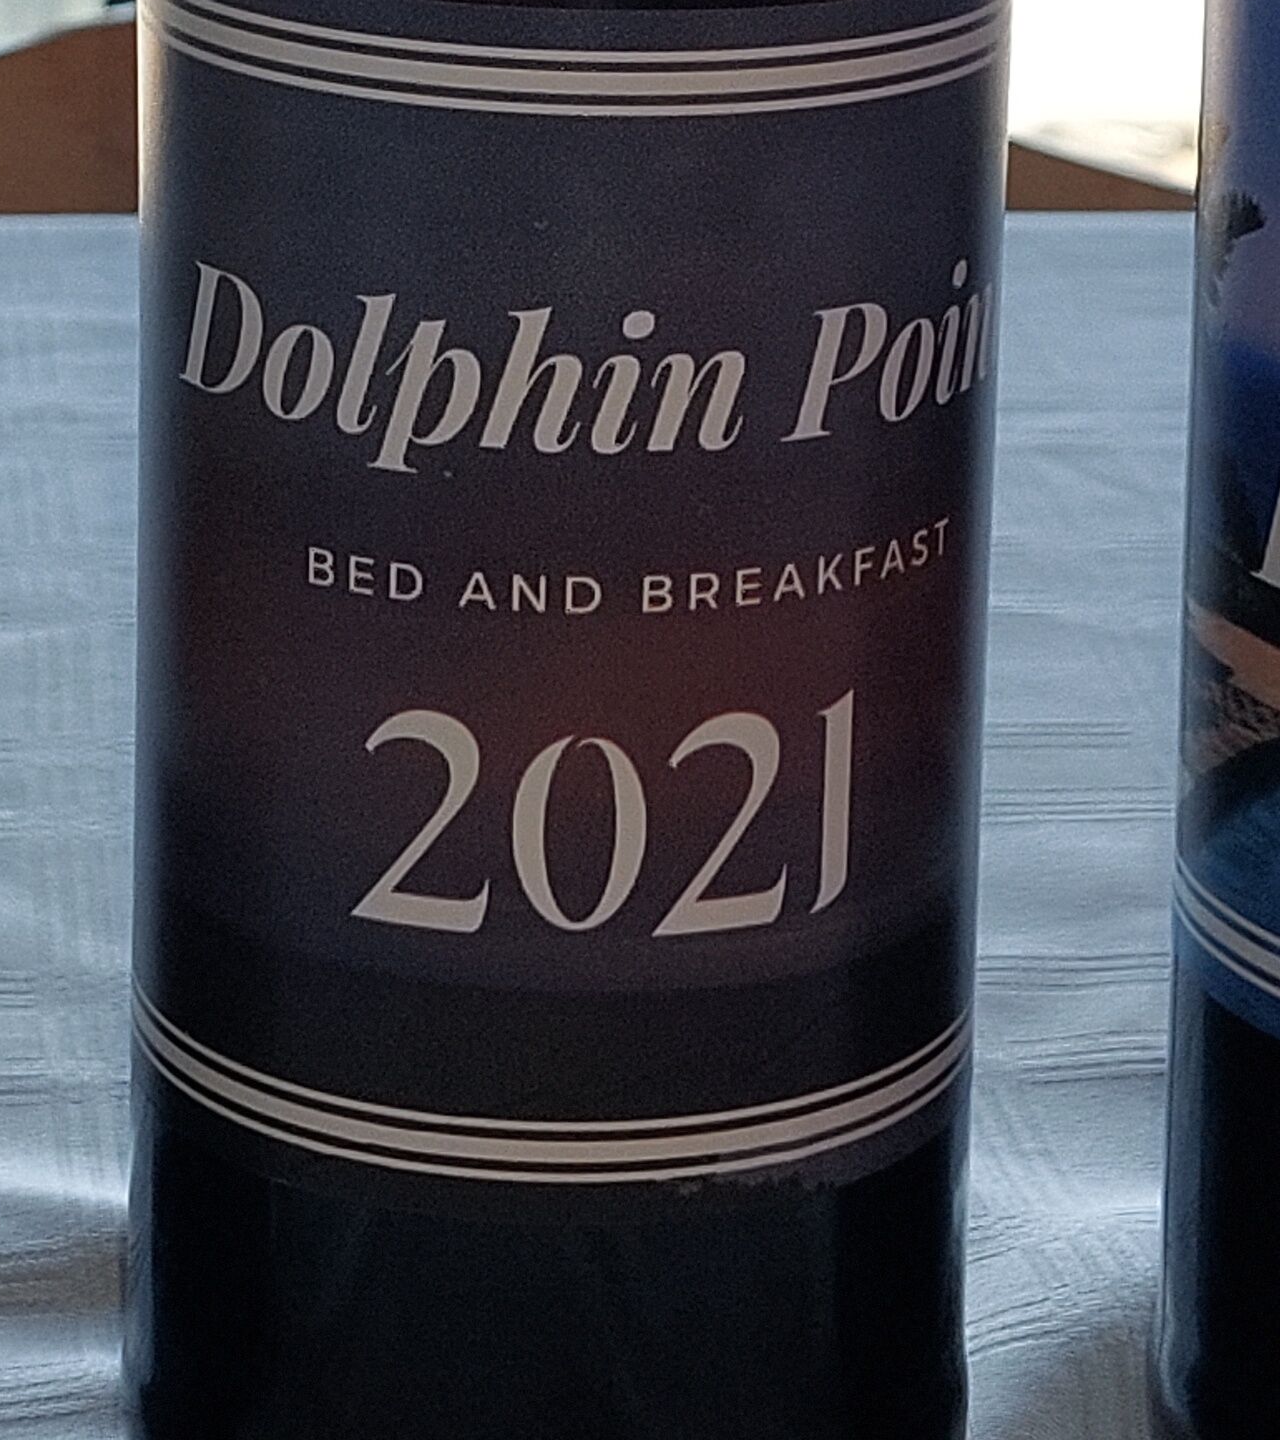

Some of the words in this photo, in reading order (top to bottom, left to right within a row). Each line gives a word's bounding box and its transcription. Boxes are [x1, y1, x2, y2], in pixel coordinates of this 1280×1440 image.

[179, 260, 747, 472] Dolphin
[306, 546, 424, 602] BED
[459, 571, 603, 614] AND
[640, 517, 951, 615] BREAKFAST
[349, 688, 856, 939] 2021
